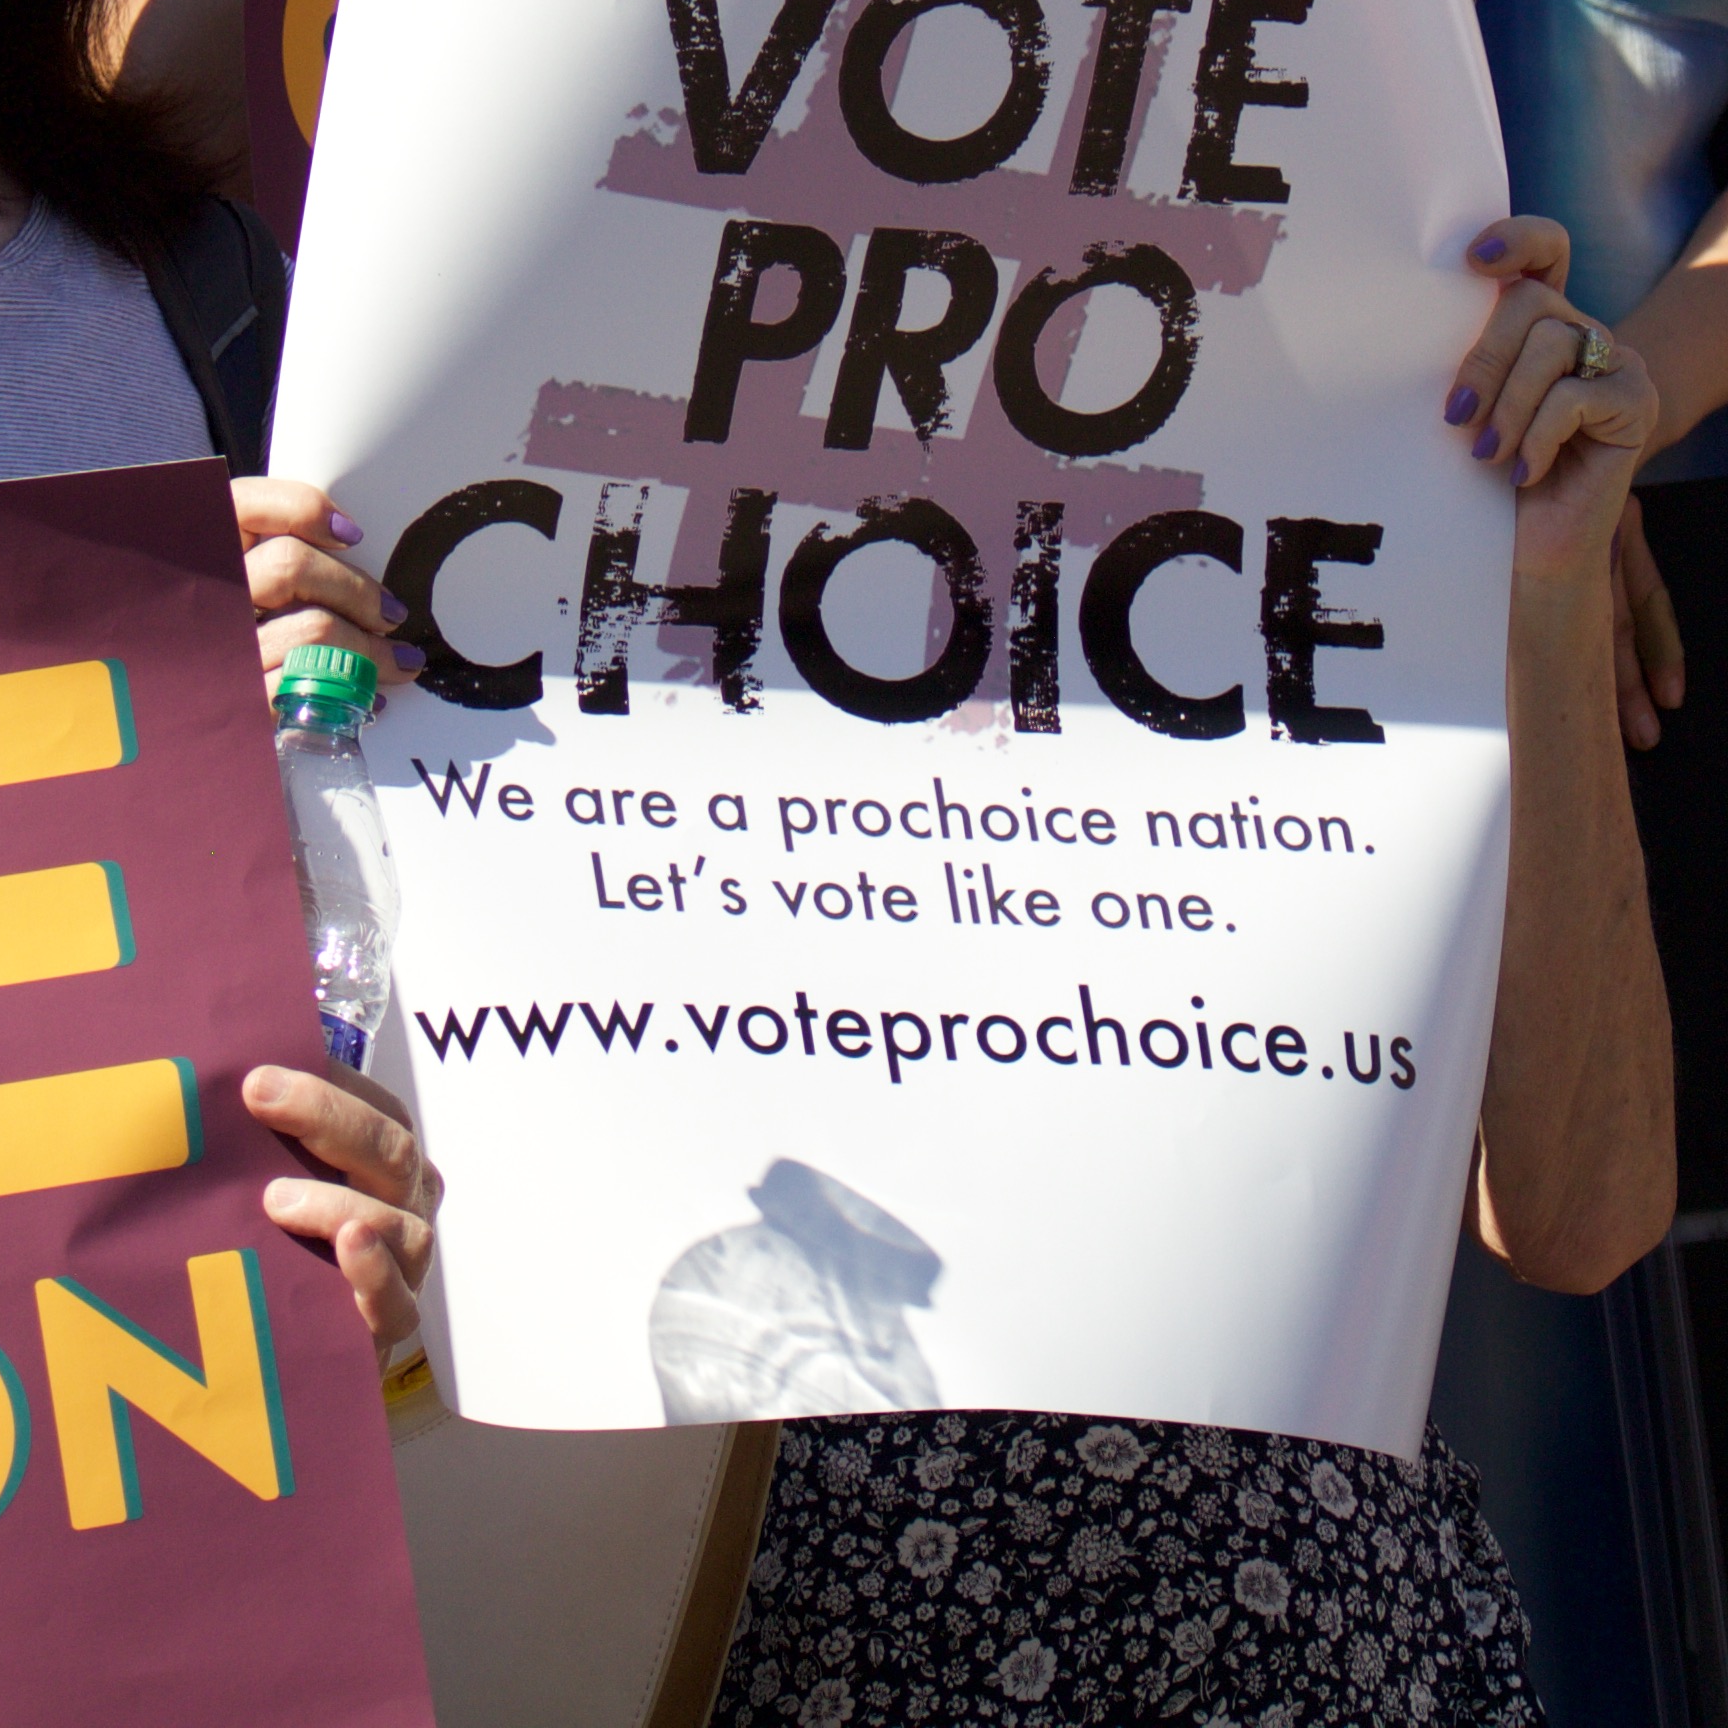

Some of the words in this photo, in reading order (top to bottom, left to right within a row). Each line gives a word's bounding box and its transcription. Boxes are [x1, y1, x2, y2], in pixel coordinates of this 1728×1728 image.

[681, 217, 1200, 460] PRO
[381, 478, 1386, 746] CHOICE
[410, 756, 536, 822] We
[564, 781, 677, 830] are
[706, 791, 749, 834] a
[780, 775, 1118, 850] prochoice
[1146, 796, 1377, 858] nation.
[592, 849, 748, 920] Let's
[772, 867, 919, 924] vote
[945, 865, 1062, 932] like
[1091, 886, 1238, 936] one.
[415, 983, 1418, 1094] www.voteprochoice.us
